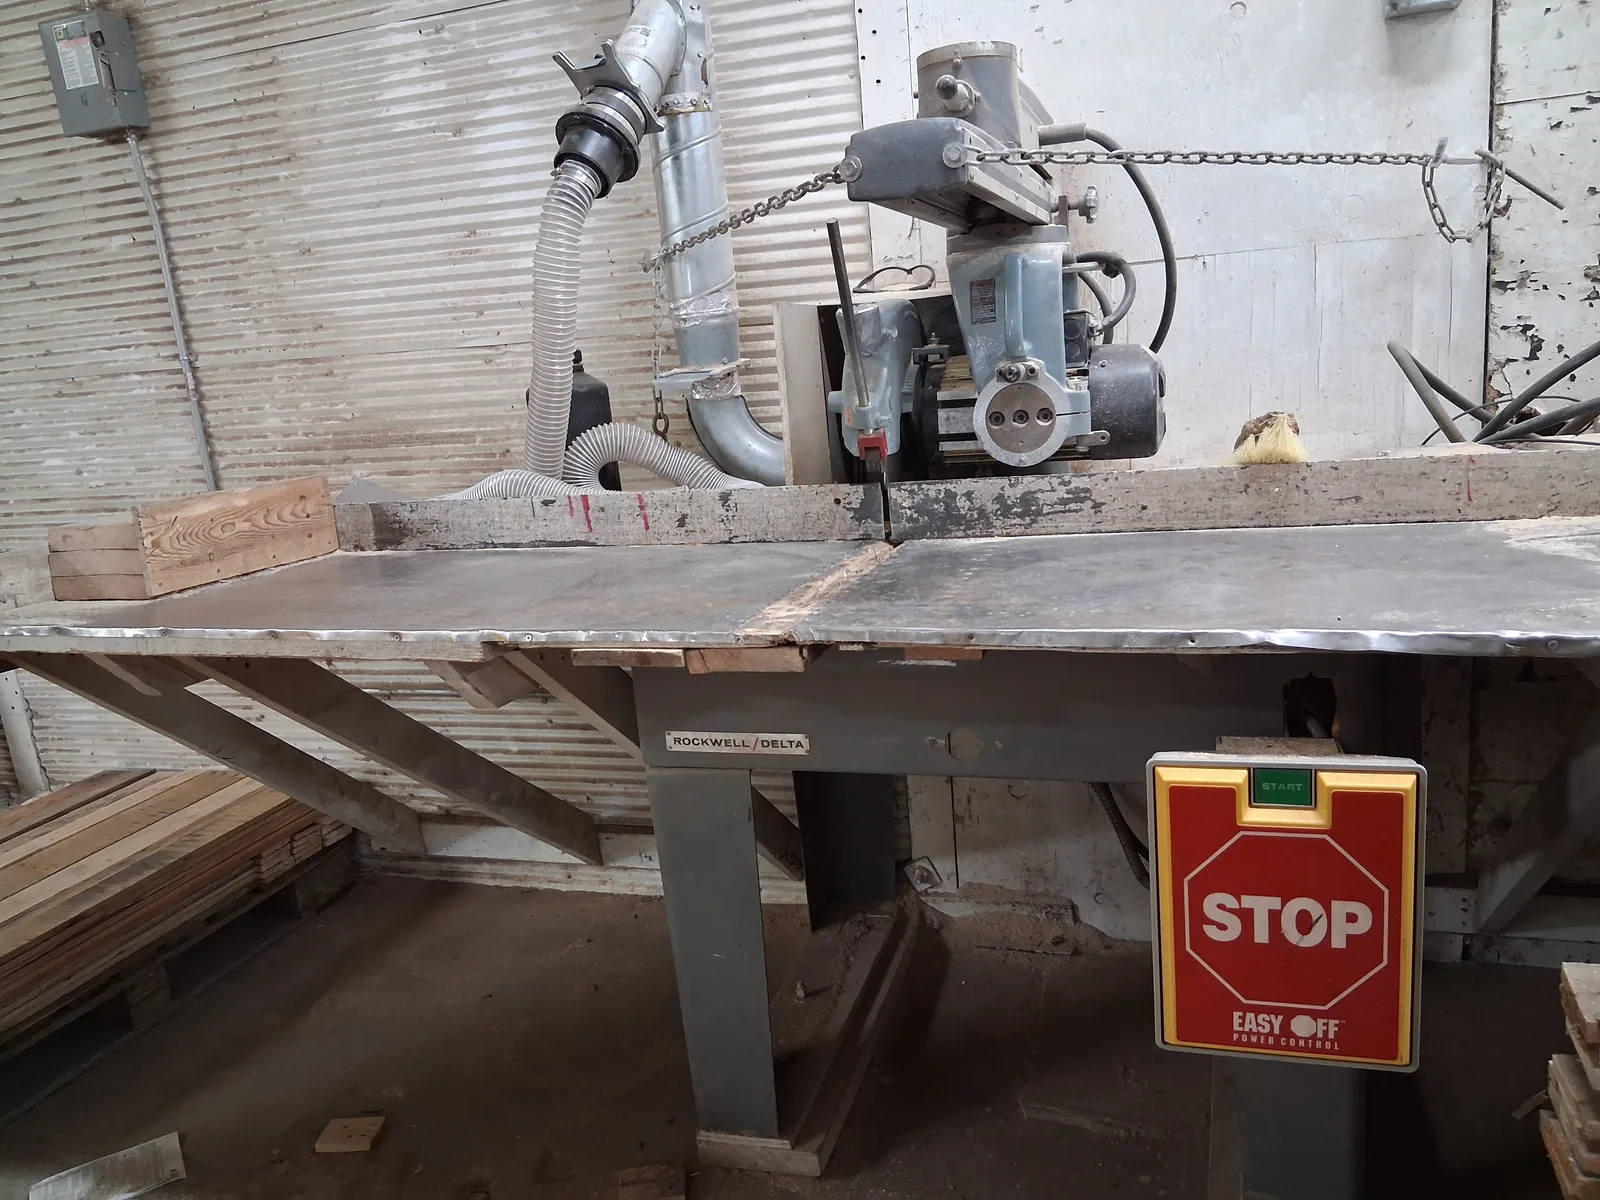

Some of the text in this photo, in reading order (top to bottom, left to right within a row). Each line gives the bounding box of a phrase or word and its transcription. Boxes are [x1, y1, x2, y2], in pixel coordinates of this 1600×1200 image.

[1262, 782, 1304, 791] START
[1202, 892, 1373, 949] STOP
[1232, 1011, 1284, 1035] EASY
[1233, 1032, 1340, 1051] POWER CONTROL
